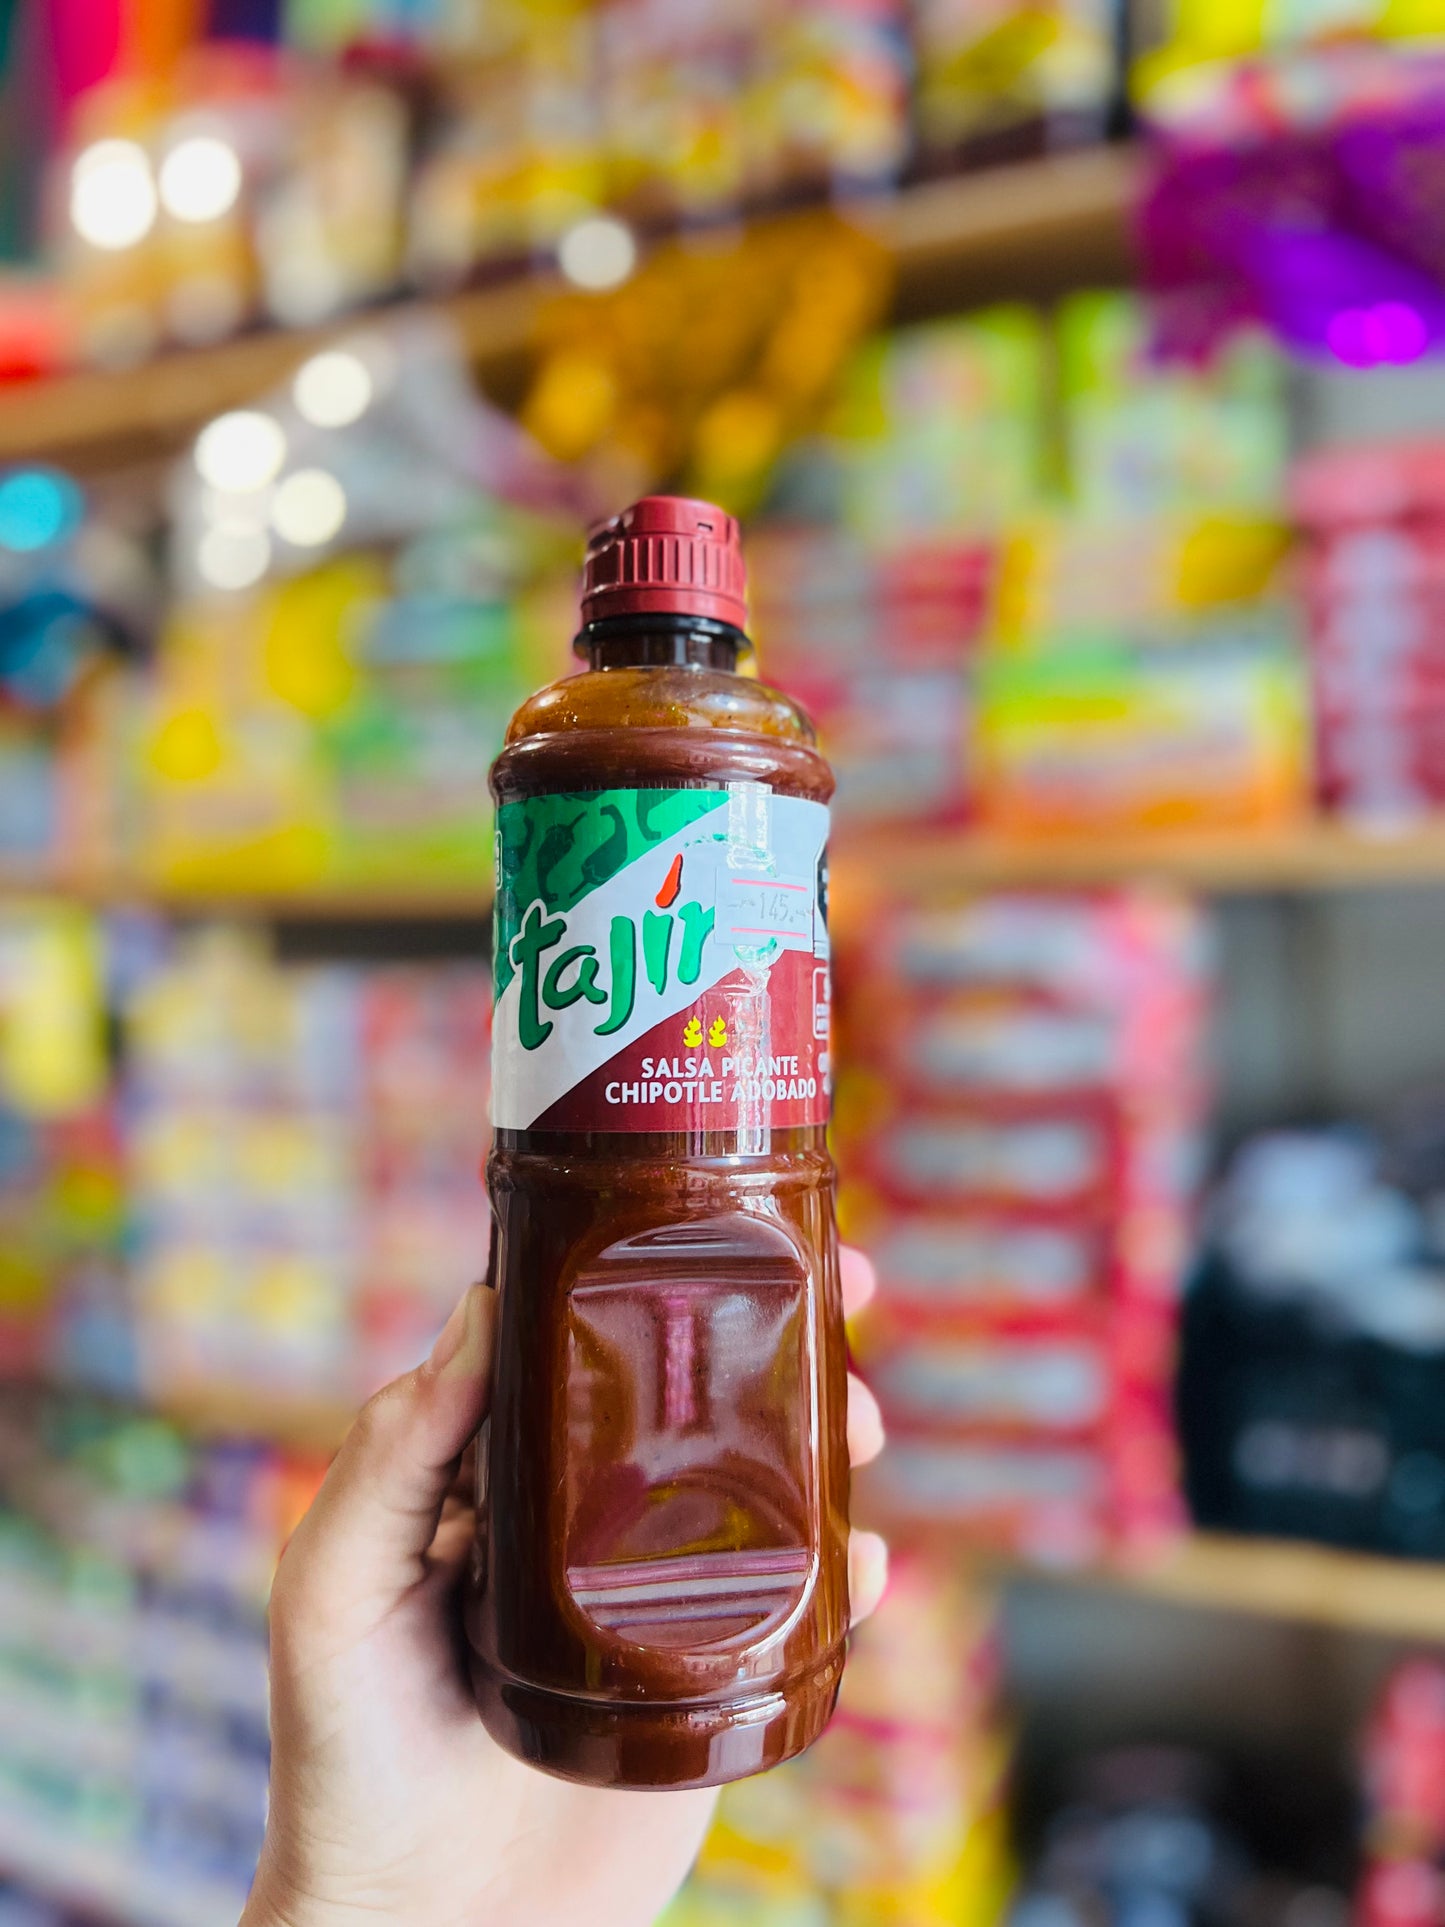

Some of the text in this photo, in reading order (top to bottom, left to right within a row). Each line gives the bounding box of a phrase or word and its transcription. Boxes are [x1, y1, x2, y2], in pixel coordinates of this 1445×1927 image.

[641, 1057, 714, 1079] SALSA
[721, 1055, 798, 1078] PICANTE
[604, 1077, 817, 1104] CHIPOTLE ADOBADO
